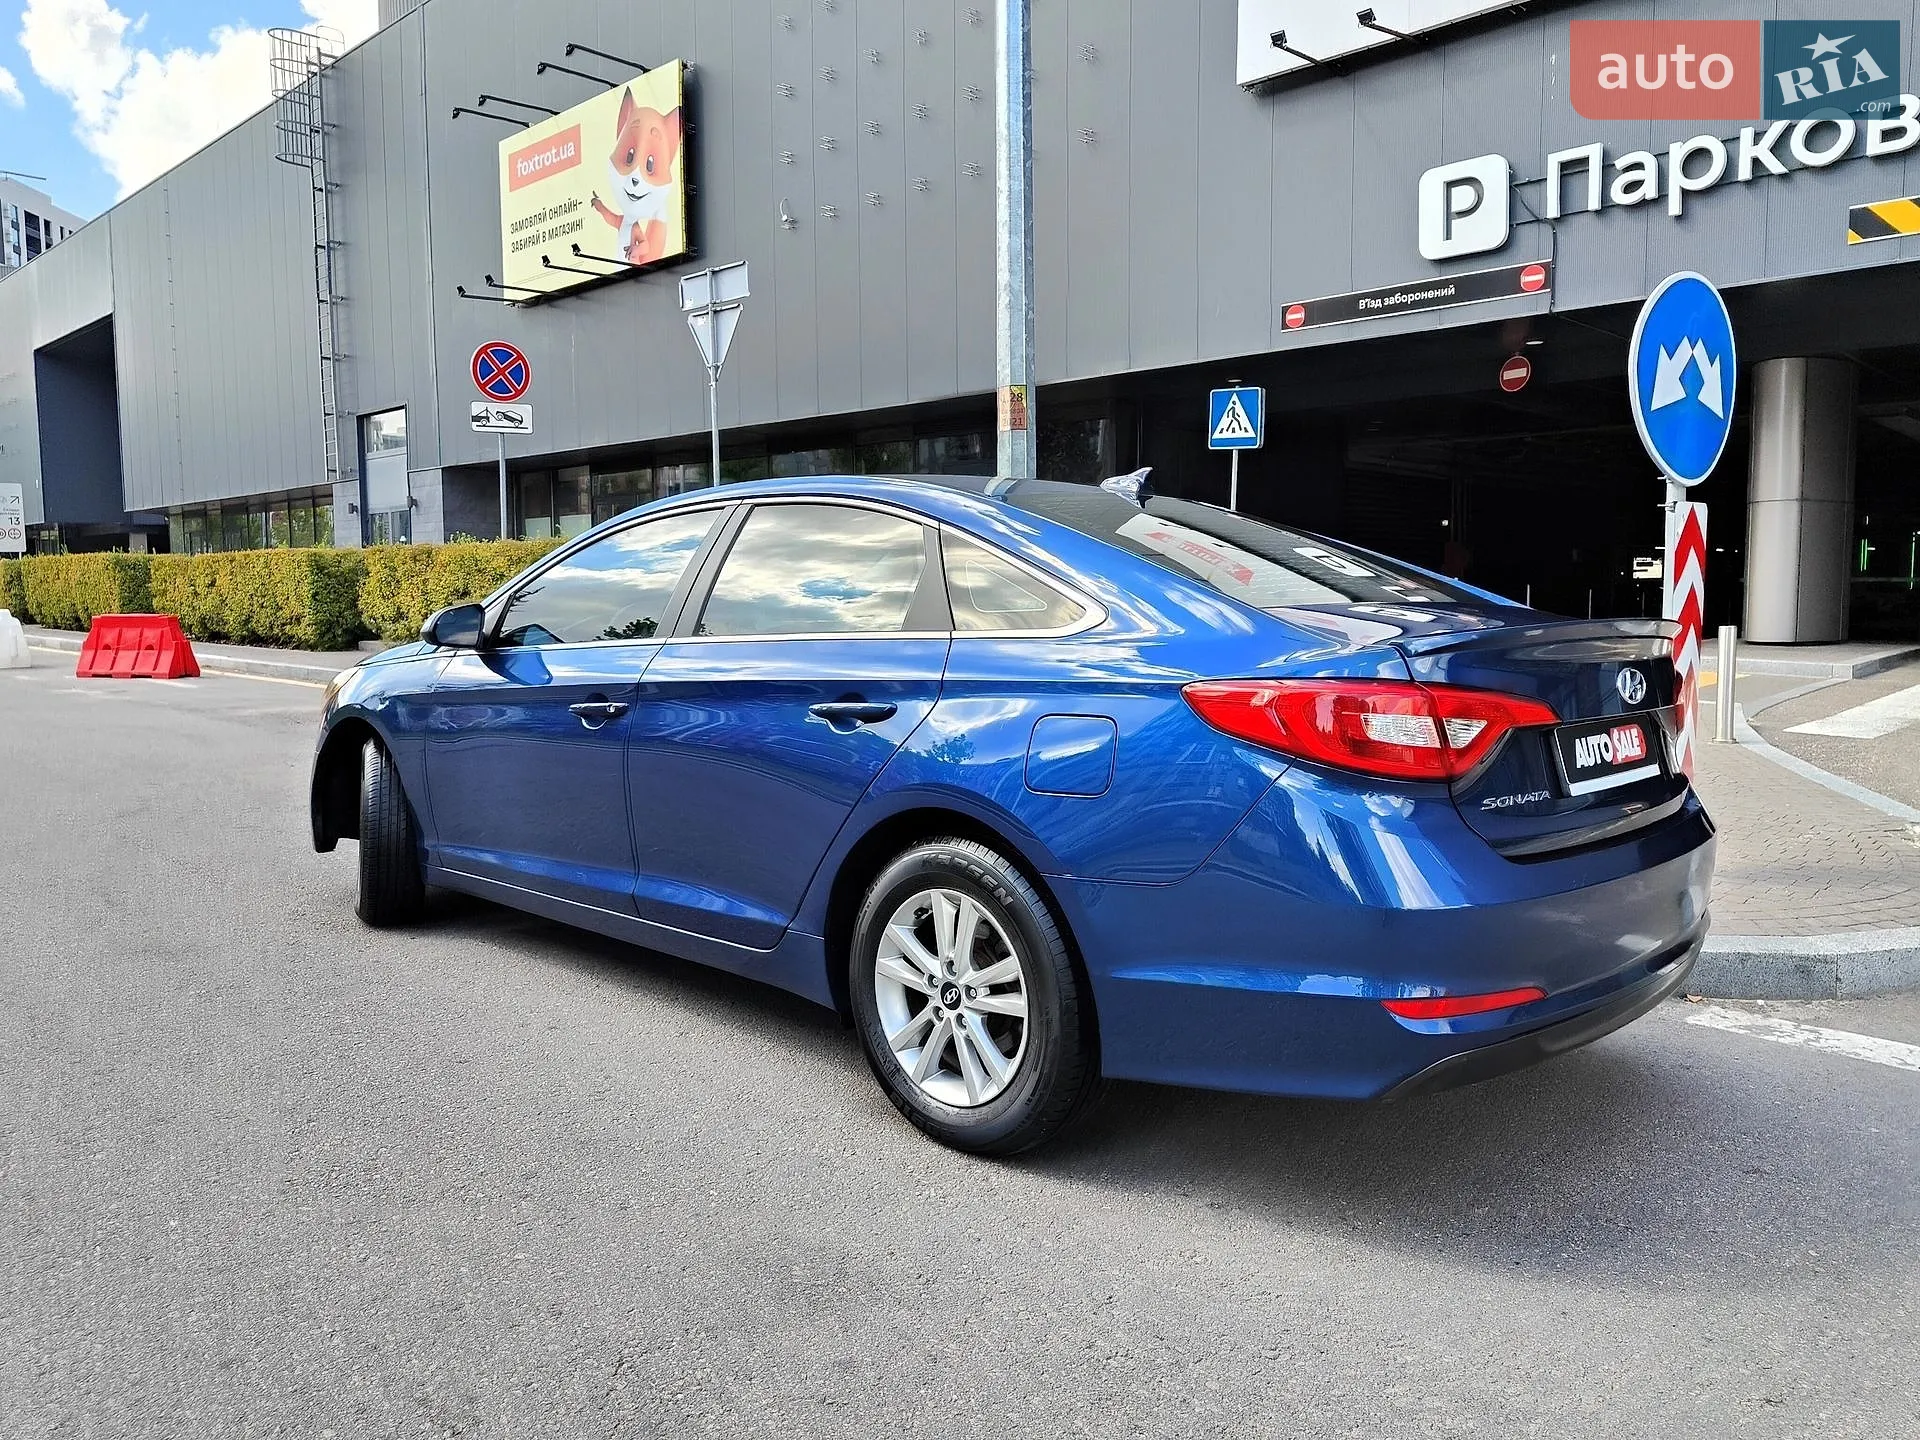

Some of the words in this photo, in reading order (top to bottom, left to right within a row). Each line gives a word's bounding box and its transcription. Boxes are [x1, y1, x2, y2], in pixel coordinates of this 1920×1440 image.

[516, 141, 576, 177] foxtrot.ua
[510, 207, 548, 235] ЗАМОВЛЯЙ
[511, 230, 541, 253] ЗАБИРАЙ
[542, 231, 547, 243] В
[1383, 284, 1455, 305] заборонений
[8, 516, 21, 526] 13
[1575, 734, 1613, 769] AUTO
[1481, 790, 1551, 811] SONATA
